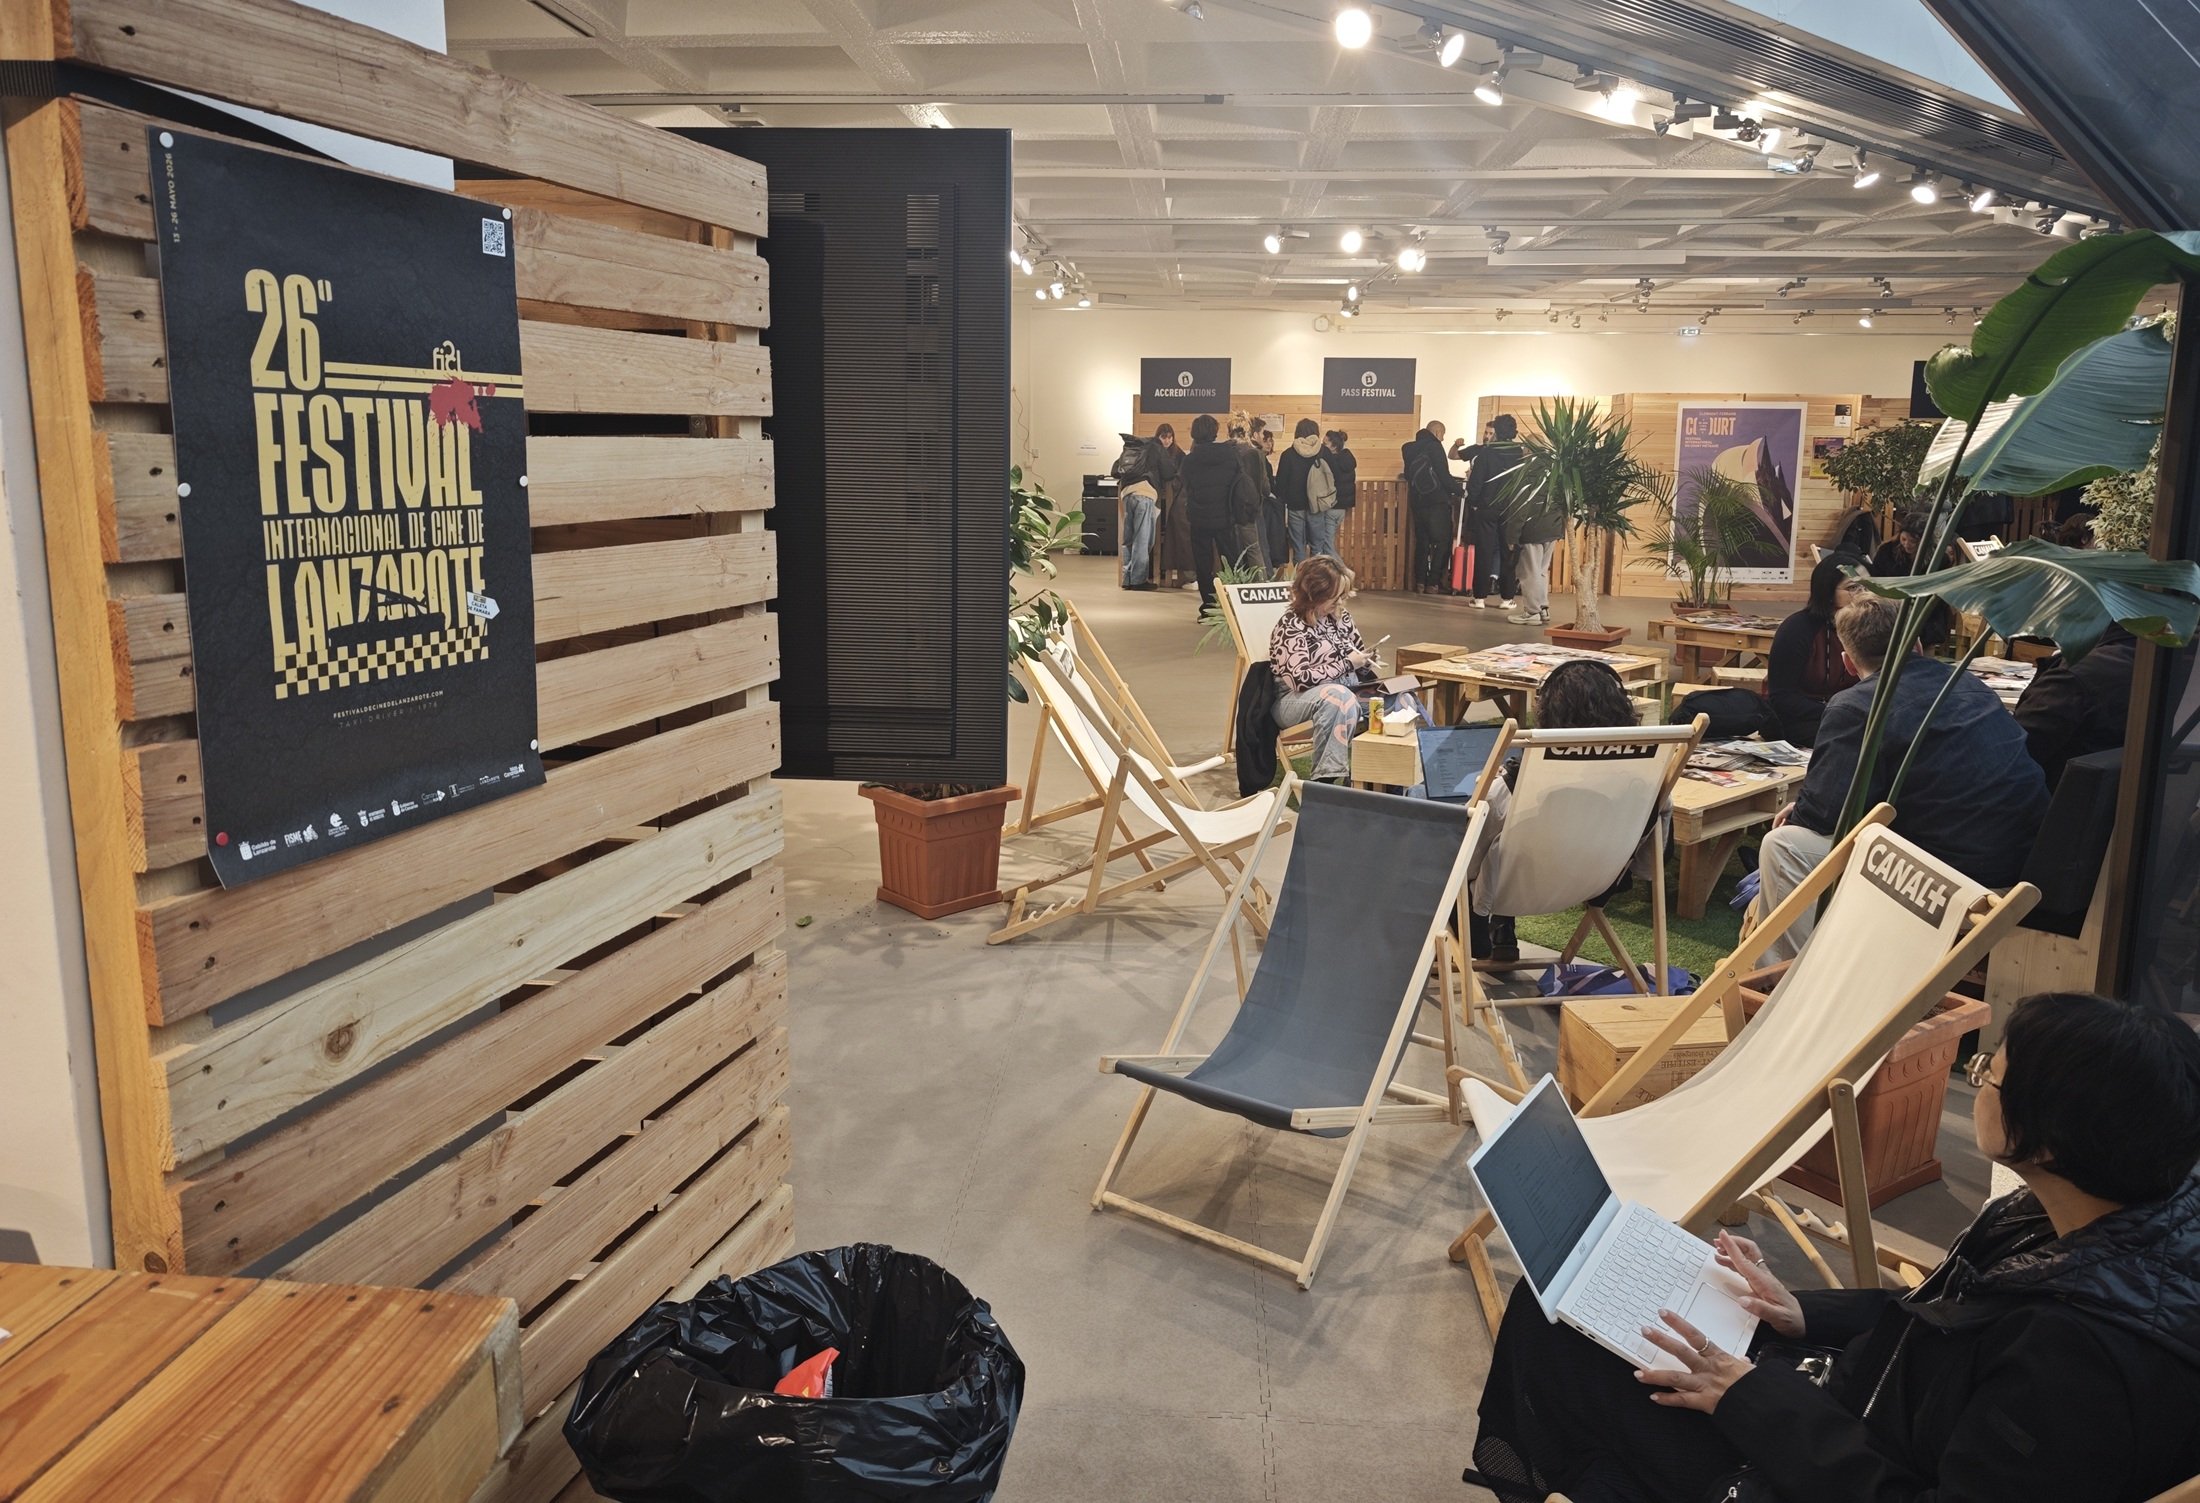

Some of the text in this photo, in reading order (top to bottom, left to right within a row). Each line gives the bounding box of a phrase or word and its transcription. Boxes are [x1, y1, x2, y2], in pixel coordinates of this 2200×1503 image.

[168, 180, 176, 209] MAYO
[1154, 388, 1216, 398] ACCREDITATIONS
[1341, 388, 1396, 398] PASS FESTIVAL
[253, 393, 483, 515] FESTIVAL
[262, 508, 485, 560] INTERNACIONAL DE CINE DE
[266, 546, 486, 658] LANZAROTE
[1240, 587, 1292, 602] CANAL+
[333, 690, 444, 719] FESTIVALDECINEDELANZAROTE.COM
[1866, 844, 1947, 914] CANAL+
